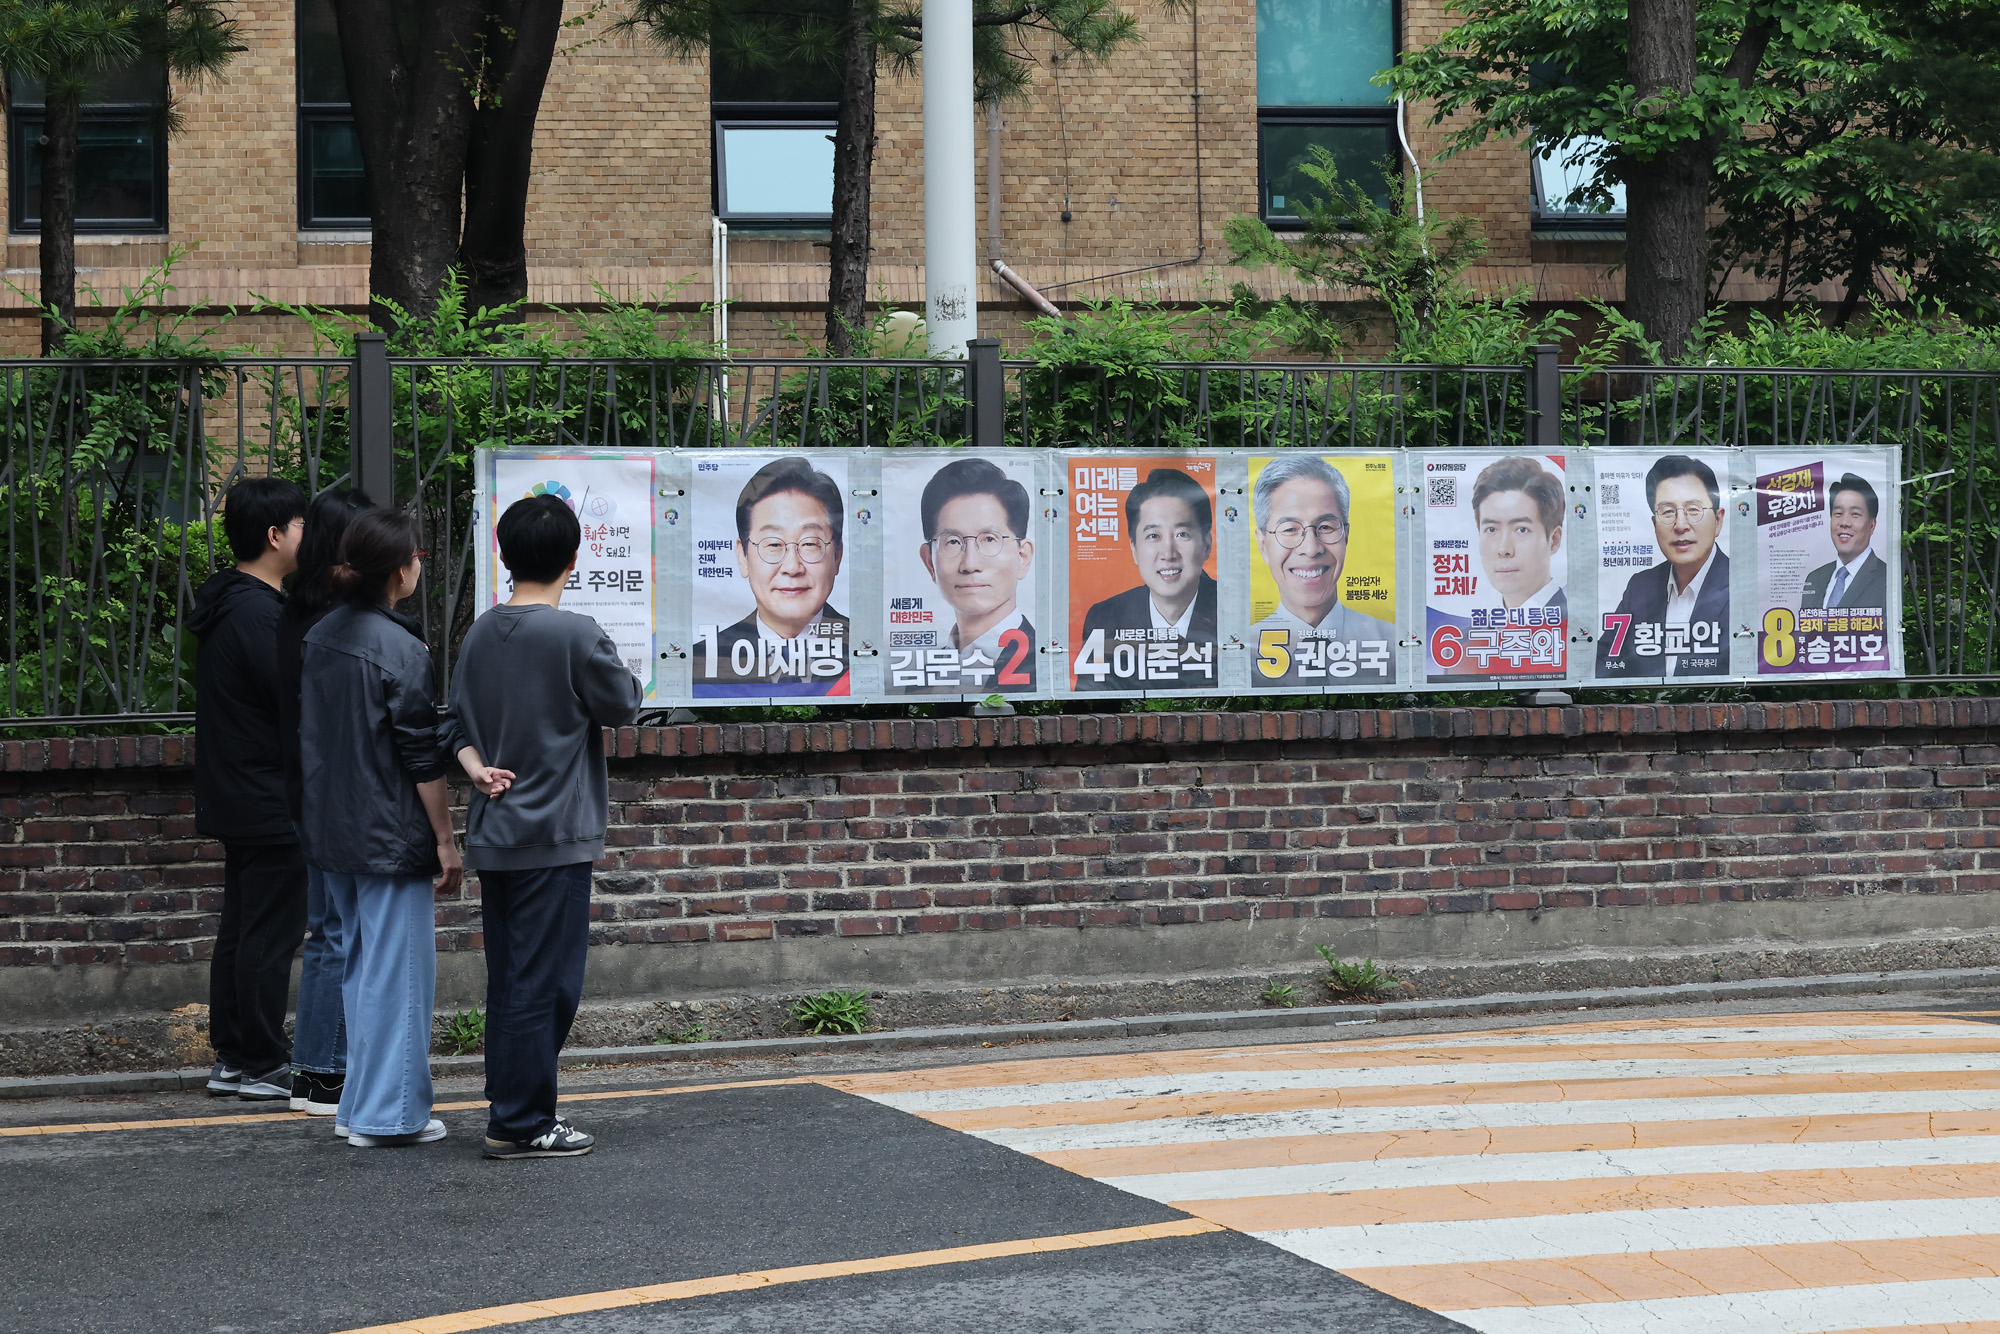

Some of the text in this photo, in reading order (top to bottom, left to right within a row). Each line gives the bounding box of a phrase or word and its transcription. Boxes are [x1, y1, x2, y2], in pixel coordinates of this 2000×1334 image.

[1435, 463, 1466, 471] 자유통일당
[1075, 467, 1138, 491] 미래를
[1075, 492, 1118, 516] 여는
[583, 523, 629, 541] 훼손하면
[1075, 517, 1119, 541] 선택
[590, 543, 630, 557] 안 돼요!
[698, 540, 733, 550] 이제부터
[1433, 540, 1469, 549] 광화문정신
[1602, 545, 1653, 556] 부정선거 척결로
[698, 554, 716, 564] 진짜
[1433, 554, 1469, 573] 정치
[1602, 557, 1653, 567] 청년에게 미래를
[698, 567, 733, 578] 대한민국
[588, 569, 644, 592] 주의문
[1346, 576, 1380, 587] 갈아엎자!
[1434, 576, 1477, 595] 교체!
[1346, 589, 1388, 600] 불평등 세상
[890, 598, 923, 610] 새롭게
[890, 611, 933, 623] 대한민국
[1799, 609, 1828, 618] 실천하는
[1828, 608, 1849, 617] 준비된
[808, 622, 843, 635] 지금은
[1850, 617, 1884, 631] 해결사
[892, 633, 934, 645] 정정당당
[1113, 628, 1179, 641] 새로운 대통령
[1297, 628, 1337, 639] 진보대통령
[1603, 613, 1721, 657] 7 황교안
[1763, 607, 1796, 667] 8
[698, 624, 844, 678] 1 이재명
[1430, 624, 1565, 669] 6 구주와
[1807, 634, 1885, 665] 송진호
[890, 628, 1031, 687] 김문수 2
[1073, 628, 1213, 682] 4 이준석
[1256, 629, 1390, 679] 5 권영국
[1605, 659, 1717, 669] 무소속 전 국무총리
